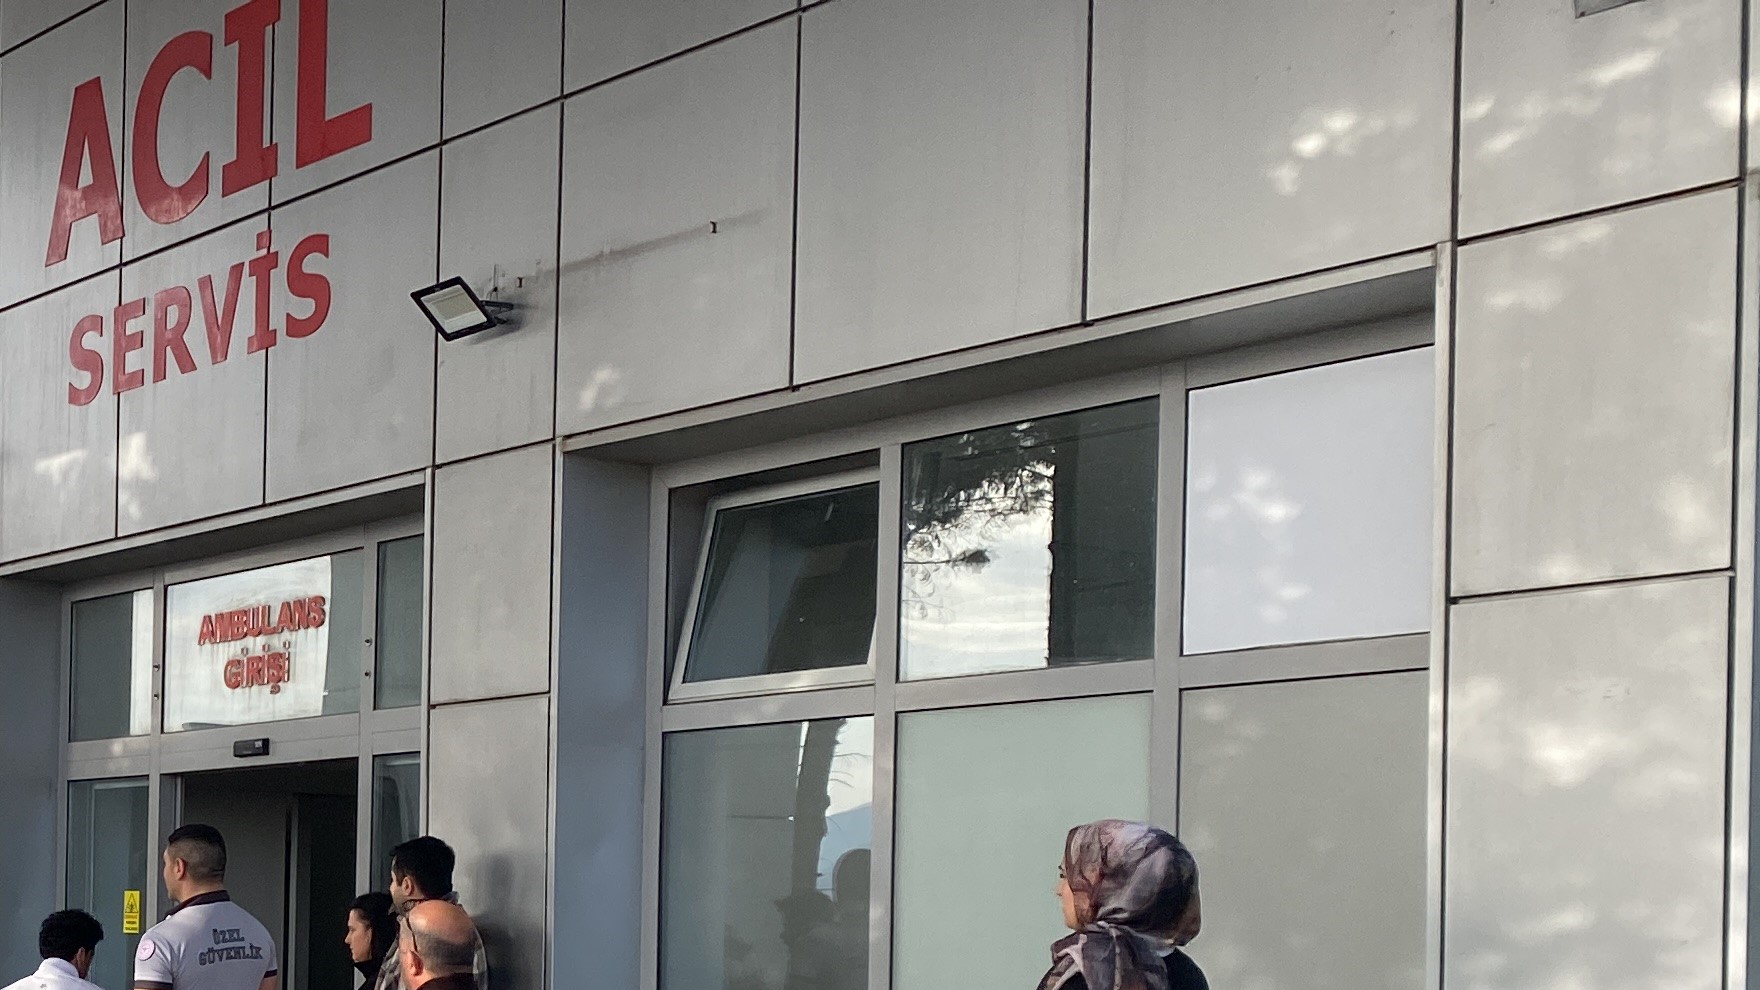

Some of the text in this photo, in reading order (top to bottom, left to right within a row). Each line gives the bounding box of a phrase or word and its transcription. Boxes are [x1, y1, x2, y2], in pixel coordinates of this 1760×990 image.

[68, 229, 332, 407] SERVİS
[198, 595, 327, 646] AMBULANS
[223, 640, 291, 695] GİRİŞİ
[198, 943, 264, 967] GÜVENLİK
[212, 928, 246, 946] ÖZEL
